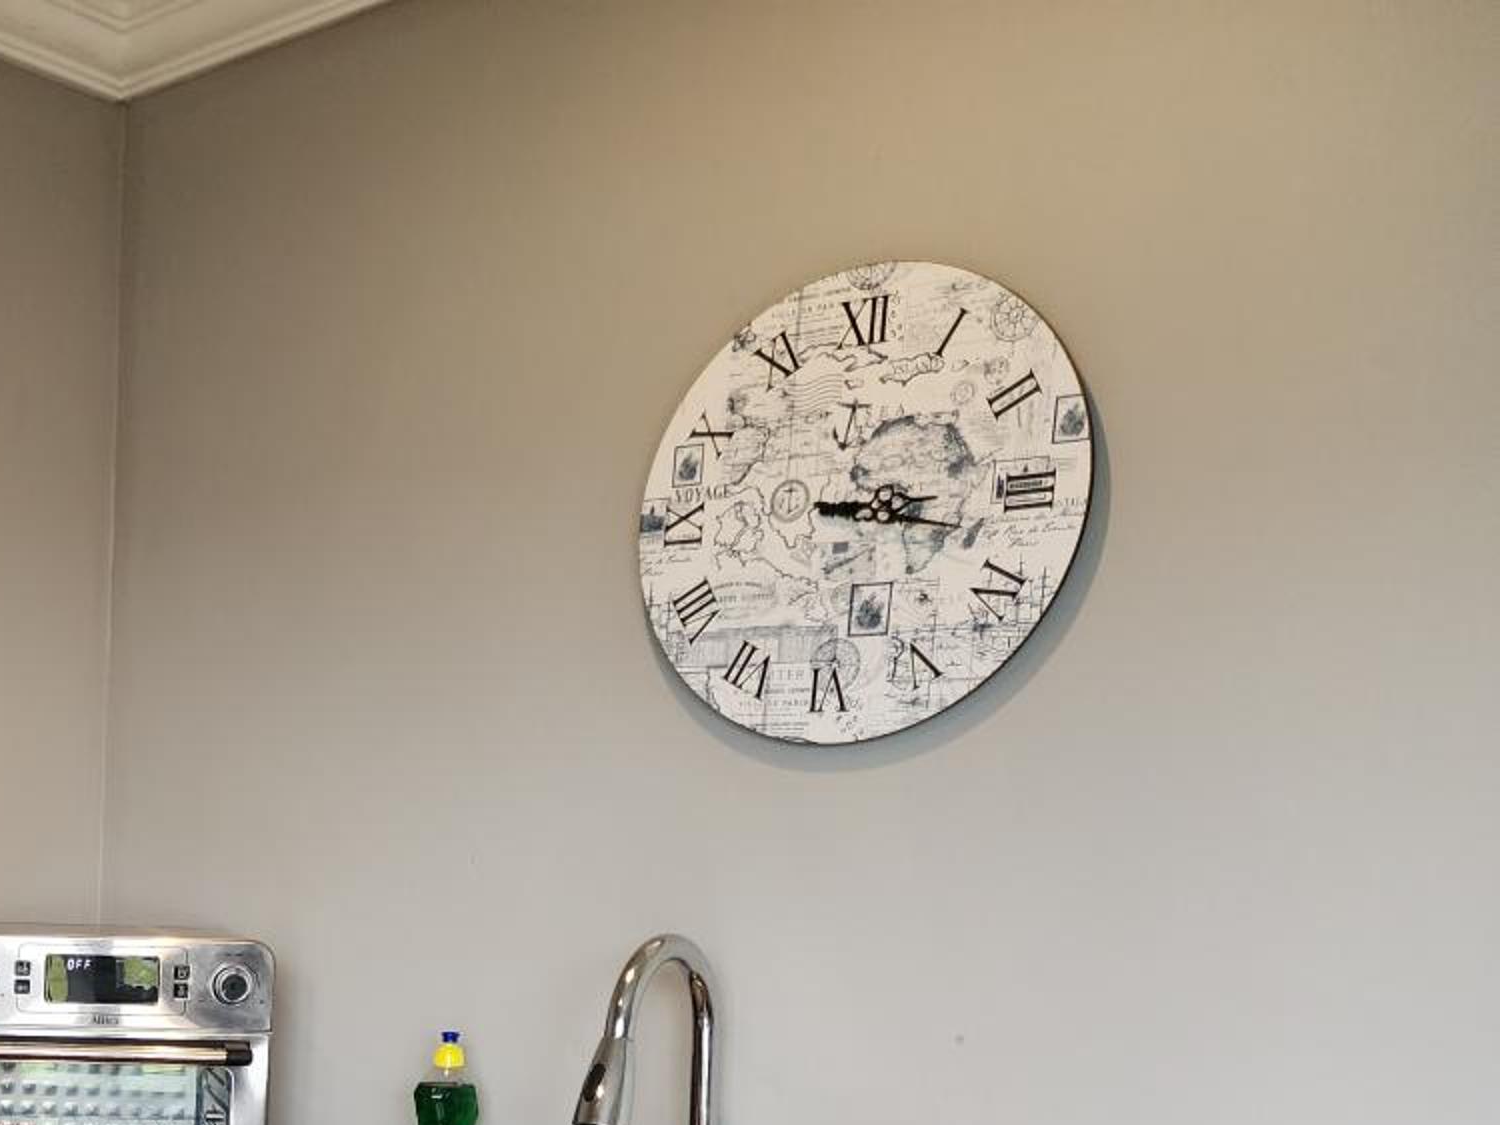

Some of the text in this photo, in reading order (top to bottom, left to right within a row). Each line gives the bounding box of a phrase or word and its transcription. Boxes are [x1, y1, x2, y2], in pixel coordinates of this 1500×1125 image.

[837, 295, 889, 350] XII
[935, 308, 970, 357] I
[753, 331, 802, 392] XI
[986, 369, 1042, 420] II
[687, 410, 735, 460] X
[1004, 468, 1056, 513] III
[664, 502, 704, 547] IX
[673, 577, 720, 645] VIII
[970, 559, 1027, 621] IV
[723, 640, 770, 701] VII
[808, 667, 849, 712] VI
[910, 642, 944, 689] V
[67, 958, 91, 971] OFF
